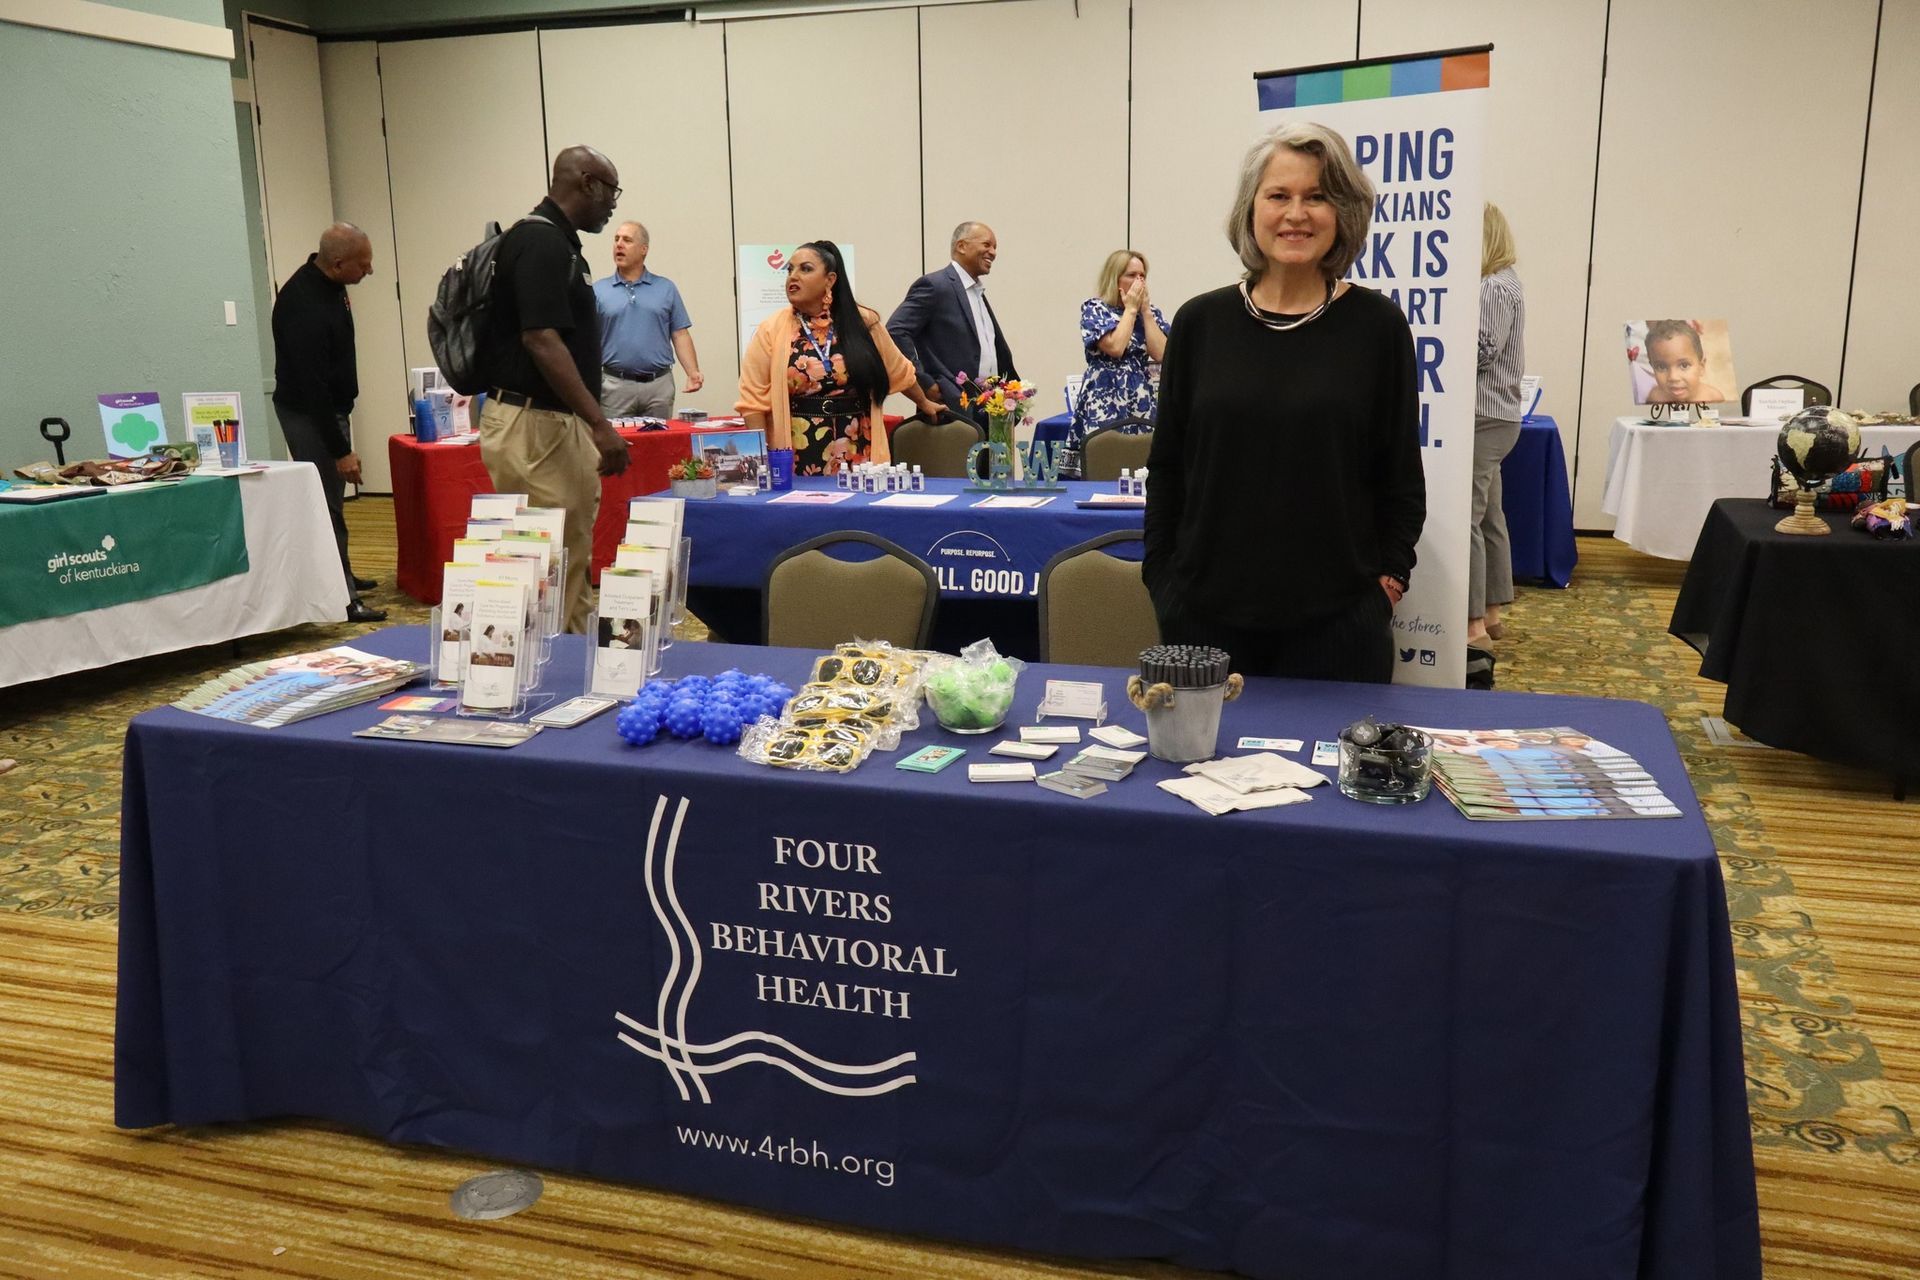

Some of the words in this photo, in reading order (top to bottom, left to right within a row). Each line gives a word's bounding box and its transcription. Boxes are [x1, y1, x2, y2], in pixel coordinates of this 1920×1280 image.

[1356, 128, 1454, 183] PING
[1374, 189, 1452, 223] KIANS
[1344, 231, 1396, 279] RK
[1412, 229, 1449, 278] IS
[1416, 336, 1445, 393] R
[47, 552, 69, 573] girl
[69, 549, 107, 566] scouts
[59, 568, 72, 585] of
[74, 561, 140, 582] kentuckiana
[940, 548, 965, 557] PURPOSE.
[966, 549, 997, 558] REPURPOSE.
[932, 566, 965, 591] LL.
[971, 568, 1024, 595] GOOD
[1028, 572, 1040, 596] J
[1390, 613, 1406, 631] he
[1408, 615, 1446, 636] stores.
[773, 835, 882, 875] FOUR
[757, 881, 892, 924] RIVERS
[709, 921, 958, 977] BEHAVIORAL
[755, 972, 912, 1020] HEALTH
[676, 1125, 895, 1187] www.4rbh.org
